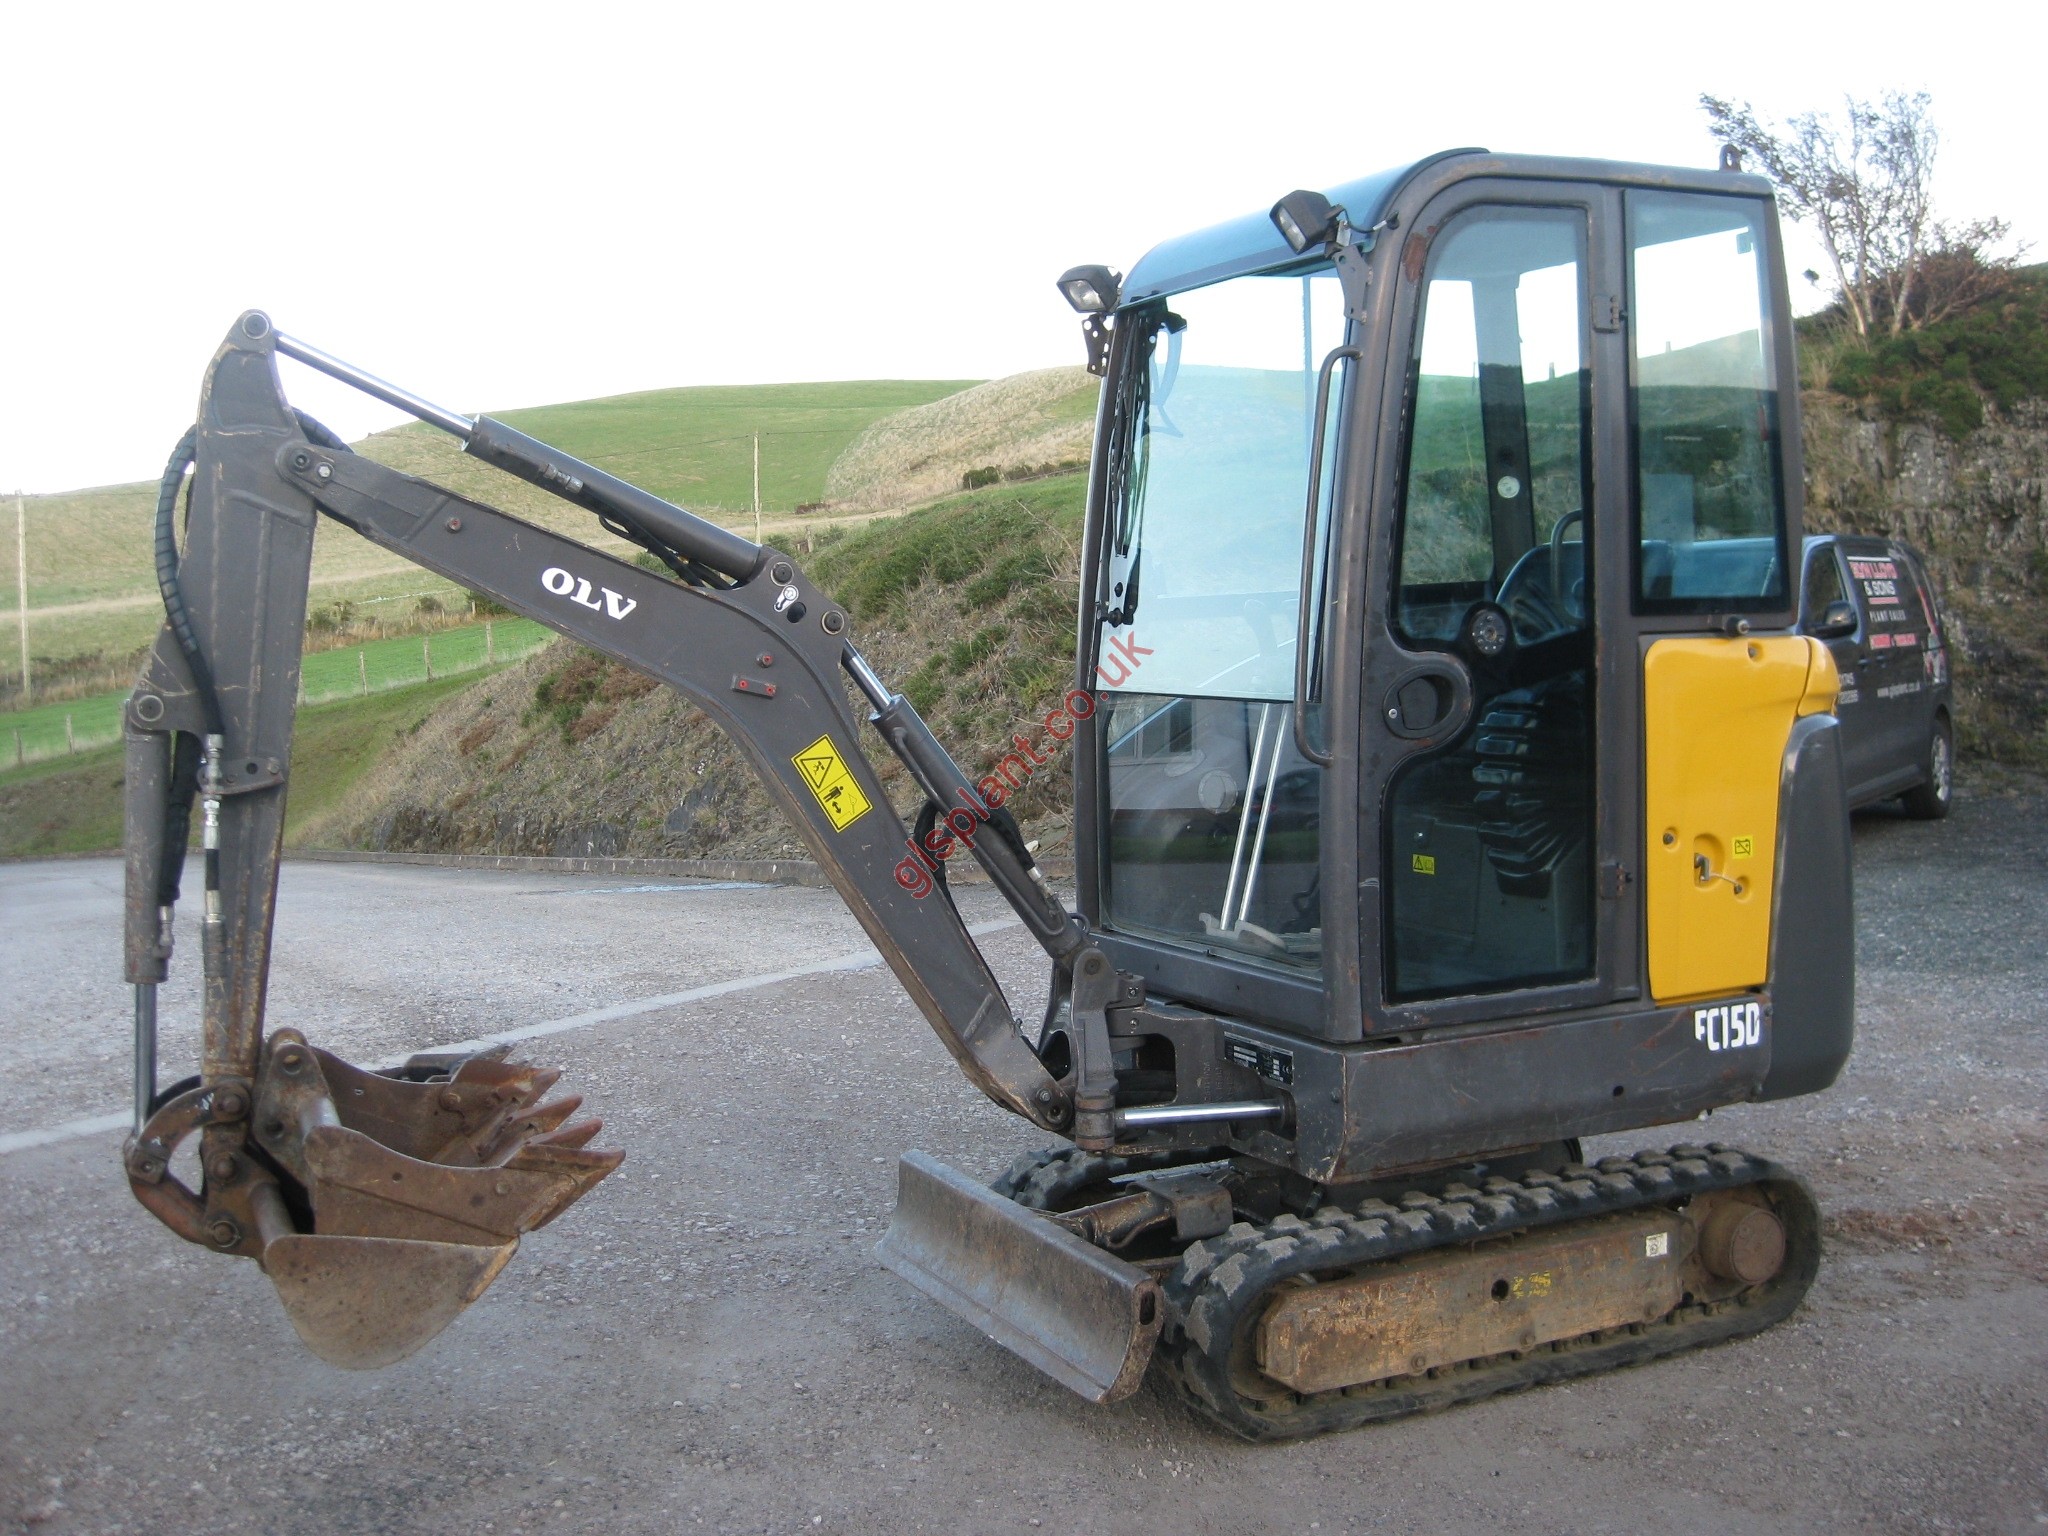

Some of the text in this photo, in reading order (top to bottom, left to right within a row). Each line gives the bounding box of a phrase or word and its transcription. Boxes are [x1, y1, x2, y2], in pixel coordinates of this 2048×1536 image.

[541, 567, 637, 620] OLV
[1863, 580, 1896, 596] & SONS
[1869, 610, 1889, 622] PLANT
